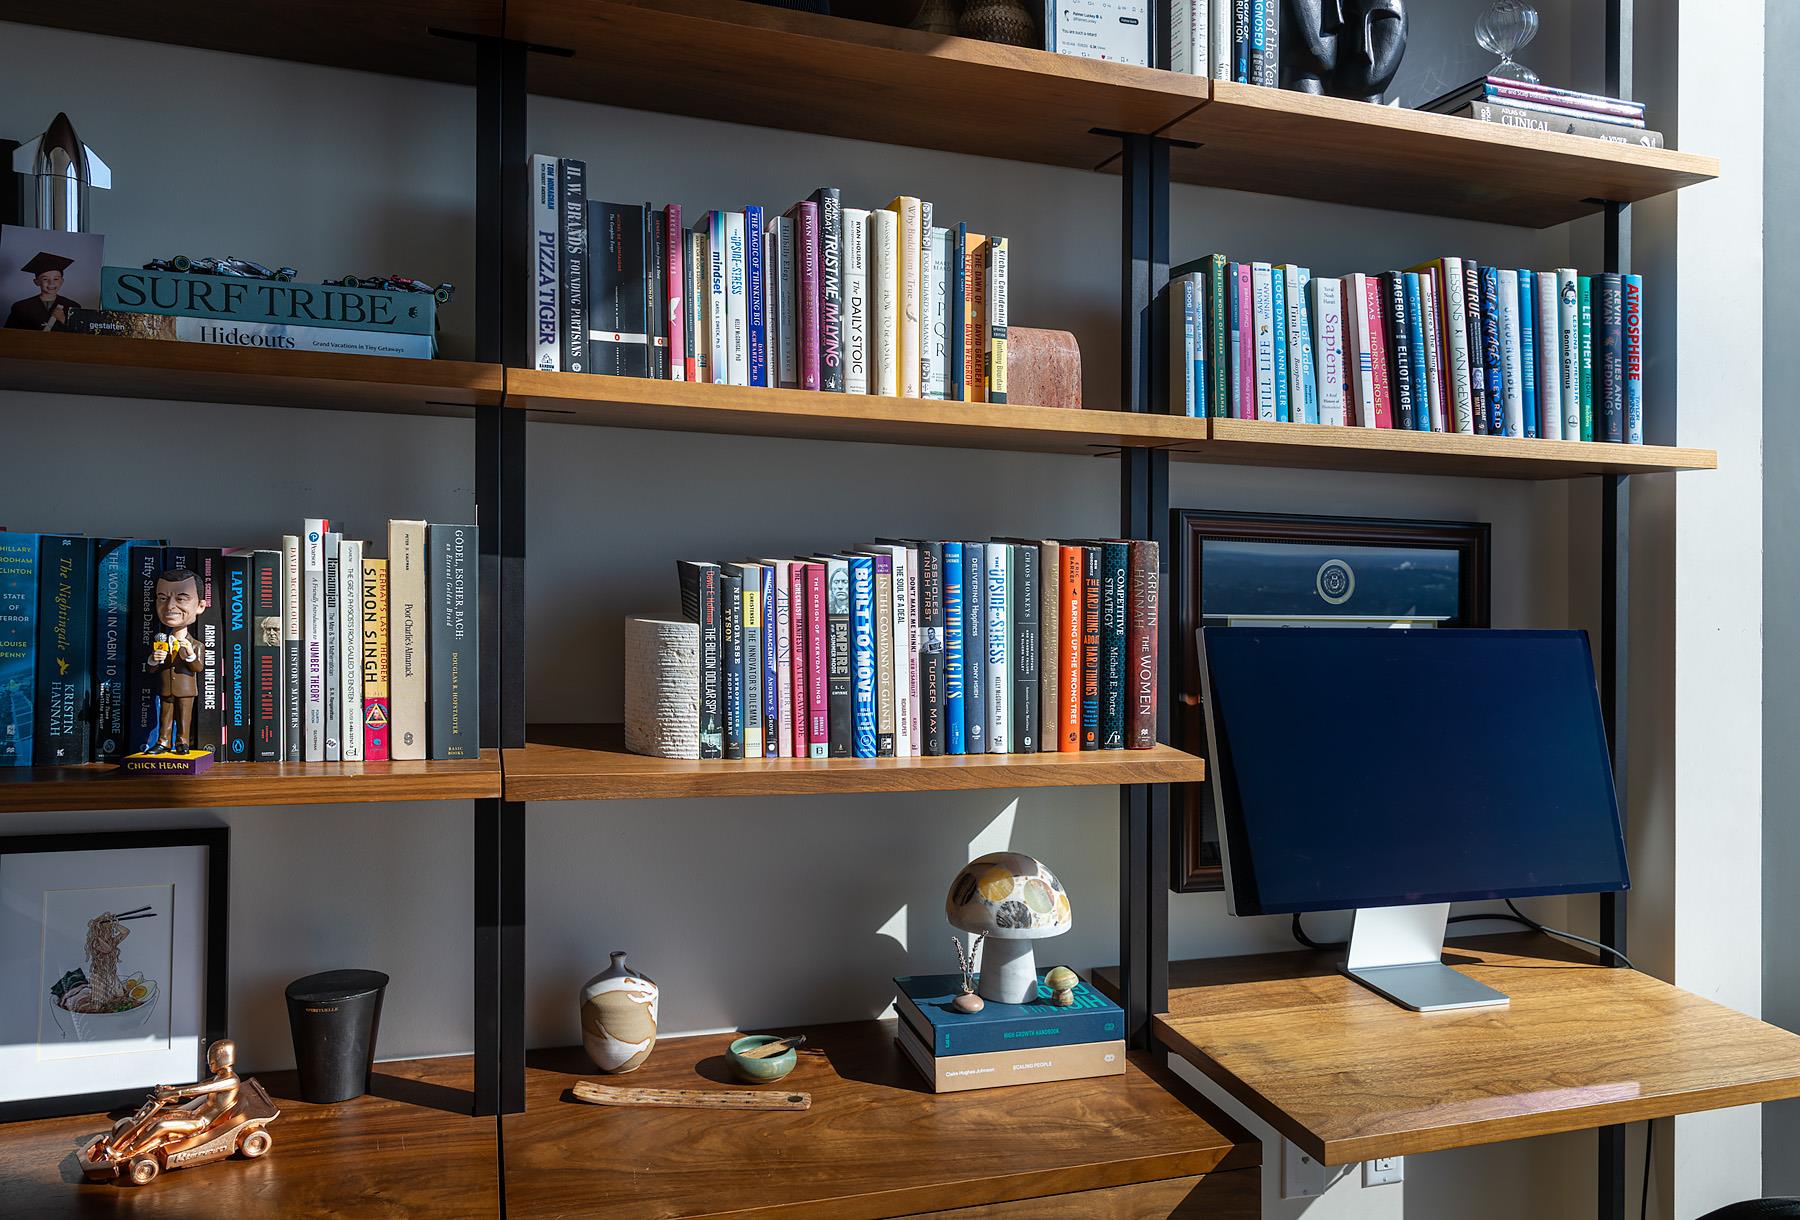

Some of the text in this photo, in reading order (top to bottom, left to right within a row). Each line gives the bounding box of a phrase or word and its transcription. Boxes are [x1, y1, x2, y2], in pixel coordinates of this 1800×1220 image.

[1266, 18, 1277, 34] of
[1266, 38, 1277, 56] the
[805, 215, 813, 237] RYAN
[831, 198, 839, 220] RYAN
[539, 230, 556, 345] PIZZA TIGER
[713, 251, 723, 294] mindset
[753, 257, 759, 269] OF
[965, 254, 973, 302] EVERYTHING
[998, 250, 1007, 326] Kitchen Confidential
[116, 274, 398, 326] SURF TRIBE
[570, 259, 582, 357] FOUNDING PARTISANS
[824, 232, 840, 368] TRUST ME, I'M LYING
[852, 297, 862, 334] DAILY
[1394, 278, 1406, 326] PAGEBOY
[1450, 267, 1464, 322] LESSONS
[1466, 269, 1481, 319] UNTRUE
[1604, 289, 1614, 326] KWAN
[1614, 290, 1622, 326] KEVIN
[89, 322, 125, 331] gestalten
[200, 325, 295, 349] Hideouts
[313, 340, 329, 348] Grand
[330, 342, 357, 350] Vacations
[365, 345, 381, 353] Tiny
[1276, 309, 1284, 342] DANCE
[1289, 304, 1301, 349] Tina Fey
[1322, 314, 1339, 386] Sapiens
[1628, 284, 1640, 381] ATMOSPHERE
[852, 335, 863, 374] STOIC
[996, 341, 1004, 364] Anthony
[1278, 348, 1287, 407] ANNE TYLER
[1293, 358, 1301, 392] Bossypants
[1524, 328, 1534, 390] TOTAL ENGAGEMENT
[1260, 341, 1273, 419] STILL LIFE
[1398, 346, 1412, 412] ELLIOT PAGE
[1456, 347, 1472, 432] IAN McEWAN
[1604, 352, 1614, 416] WEDDINGS
[1615, 384, 1623, 411] AND
[55, 558, 72, 651] The Nightingale
[142, 557, 154, 646] Fifty Shades Darker
[231, 571, 243, 632] LAPVONA
[323, 558, 339, 609] Ramanujan
[453, 530, 465, 641] GÖDEL, ESCHER, BACH:
[855, 568, 869, 618] BUILT
[1105, 578, 1114, 629] STRATEGY
[1117, 569, 1126, 636] COMPETITIVE
[1134, 570, 1145, 629] HANNAH
[1148, 572, 1157, 627] KRISTIN
[365, 568, 378, 683] SIMON SINGH
[856, 624, 870, 647] TO
[971, 605, 979, 637] Happiness
[1086, 587, 1099, 633] HARD THING
[405, 603, 414, 677] Poor Charlie's Almanack
[836, 624, 848, 675] EMPIRE
[945, 582, 963, 700] MATHEMAGICS
[1071, 639, 1078, 651] UP
[1086, 646, 1098, 668] HARD
[204, 625, 216, 710] ARMS AND INFLUENCE
[233, 643, 242, 727] OTTESSA MOSHFEGH
[291, 648, 299, 685] HISTORY
[310, 642, 320, 703] NUMBER THEORY
[705, 628, 717, 715] THE BILLION DOLLAR SPY
[857, 651, 872, 703] MOVE
[929, 659, 937, 703] TUCKER
[1085, 669, 1098, 697] THINGS
[1140, 635, 1152, 716] THE WOMEN
[50, 681, 62, 737] HANNAH
[64, 684, 75, 735] KRISTIN
[112, 682, 122, 734] RUTH WARE
[127, 762, 190, 770] CHICK HEARN
[959, 1070, 976, 1078] Hughes
[1013, 1062, 1053, 1071] SCALING PEOPLE
